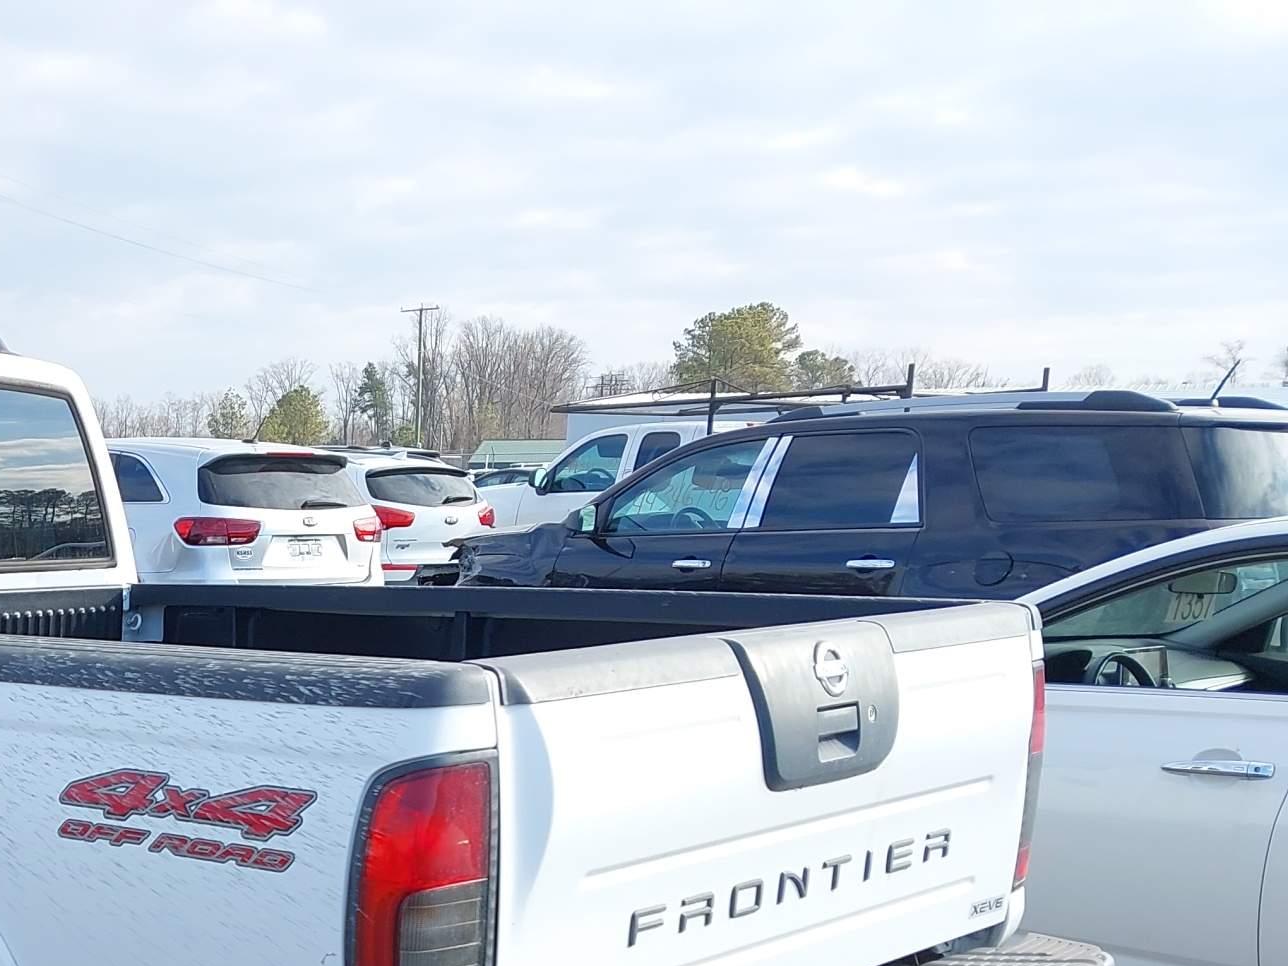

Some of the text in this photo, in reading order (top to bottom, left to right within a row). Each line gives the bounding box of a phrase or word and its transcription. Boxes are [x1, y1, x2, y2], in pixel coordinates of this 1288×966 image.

[59, 768, 317, 841] 4x4
[57, 819, 295, 872] OFF ROAD
[626, 828, 952, 948] FRONTIER
